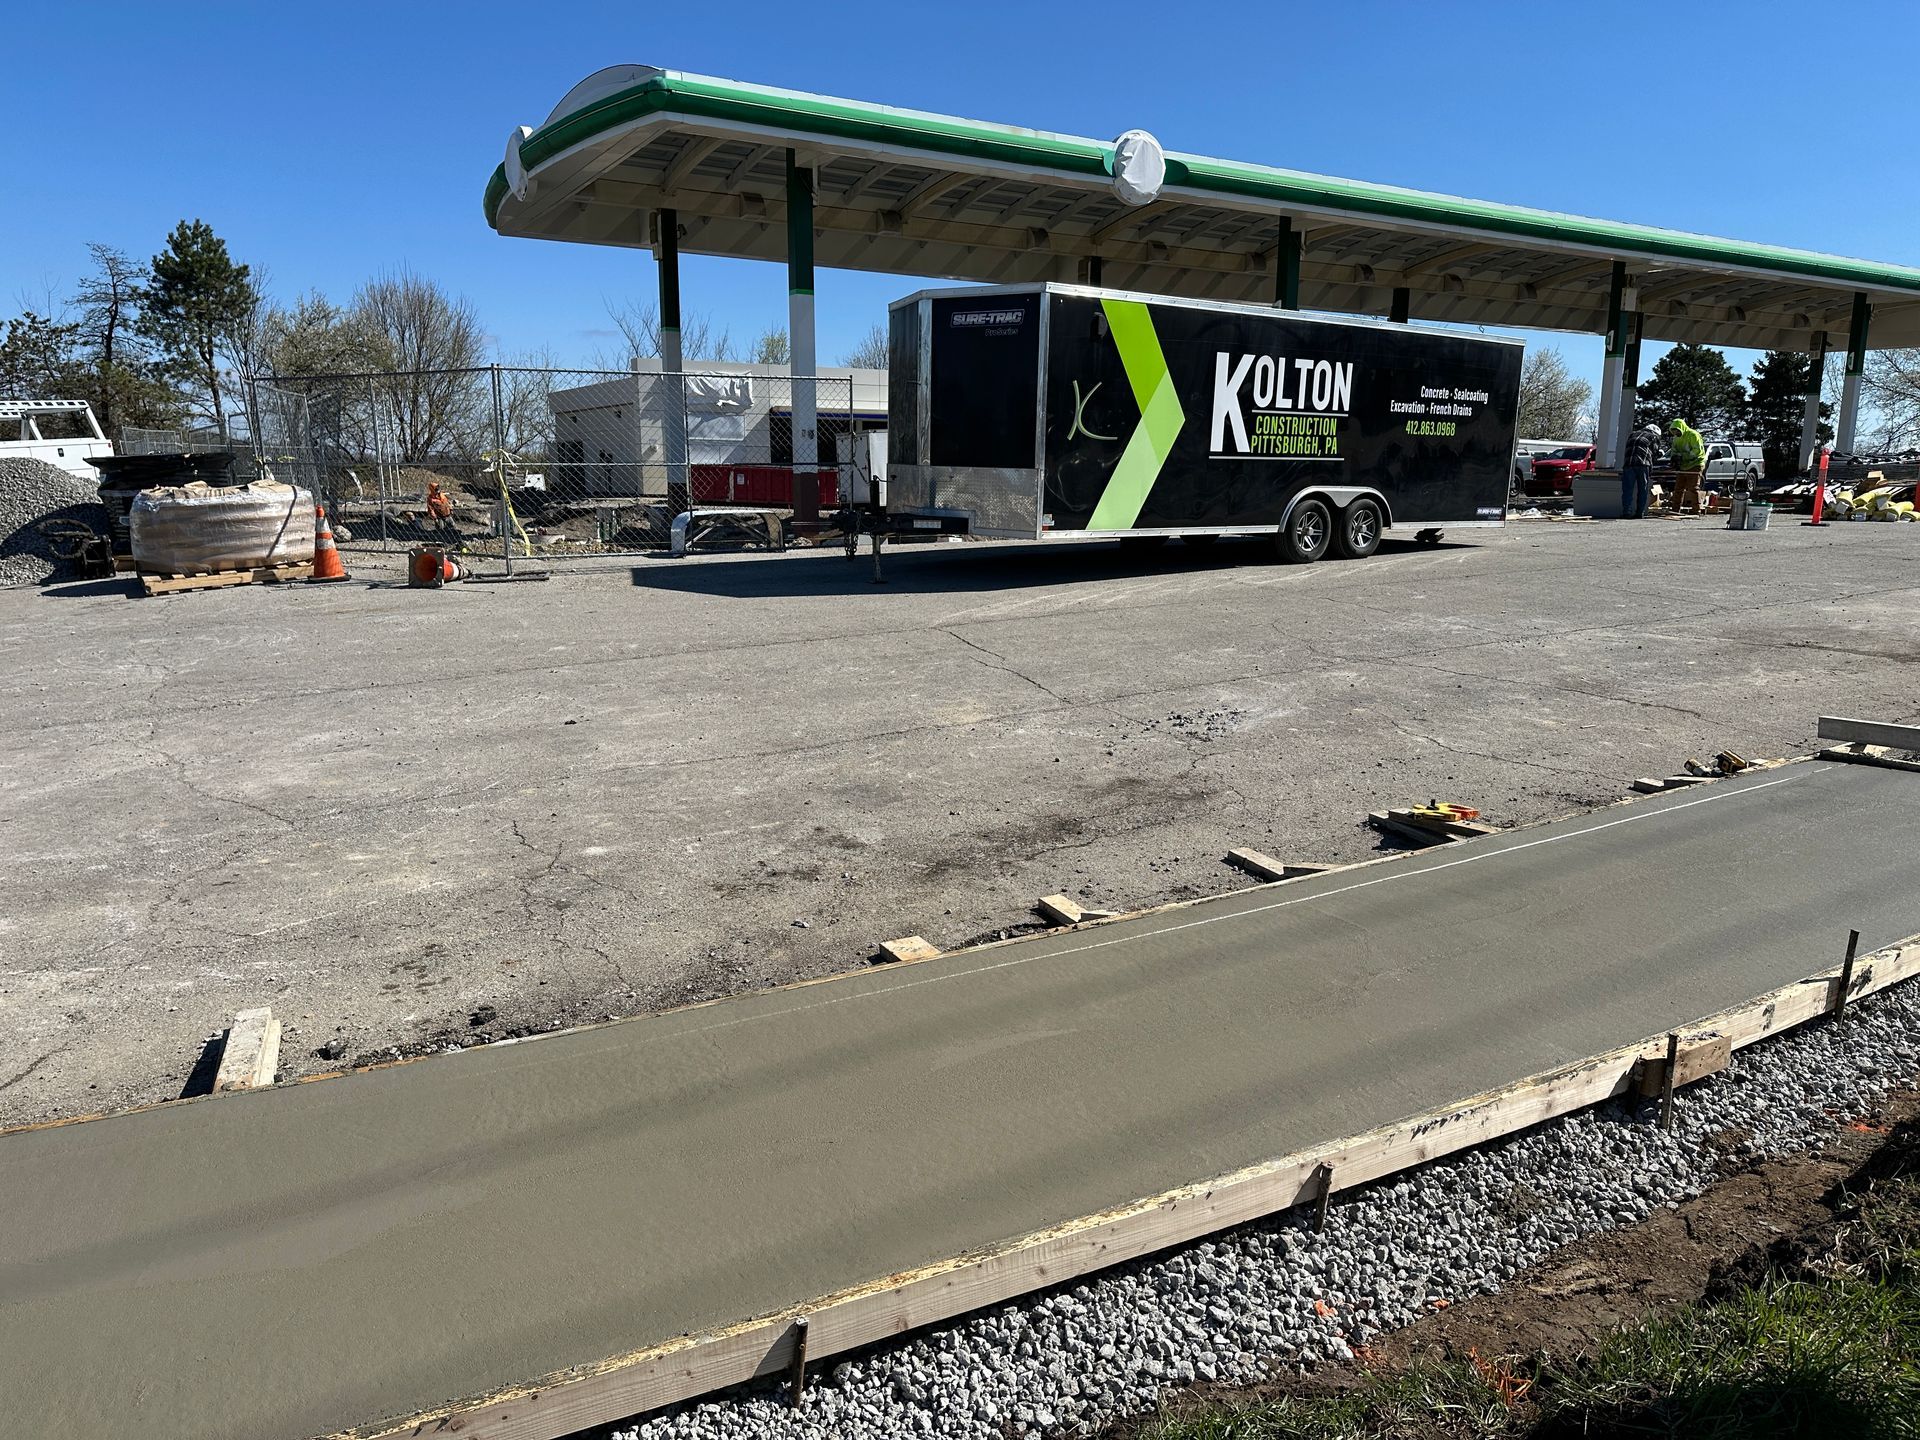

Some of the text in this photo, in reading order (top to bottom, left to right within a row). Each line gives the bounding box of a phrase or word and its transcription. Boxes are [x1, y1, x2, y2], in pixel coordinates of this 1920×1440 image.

[952, 311, 1022, 326] SURE-TRAC
[1209, 351, 1354, 453] KOLTON
[1420, 385, 1489, 405] Concrete Sealcoating
[1390, 399, 1473, 417] Excavation French Drains
[1255, 415, 1338, 436] CONSTRUCTION
[1405, 420, 1456, 436] 412.863.0968
[1250, 435, 1338, 457] PITTSBURGH, PA
